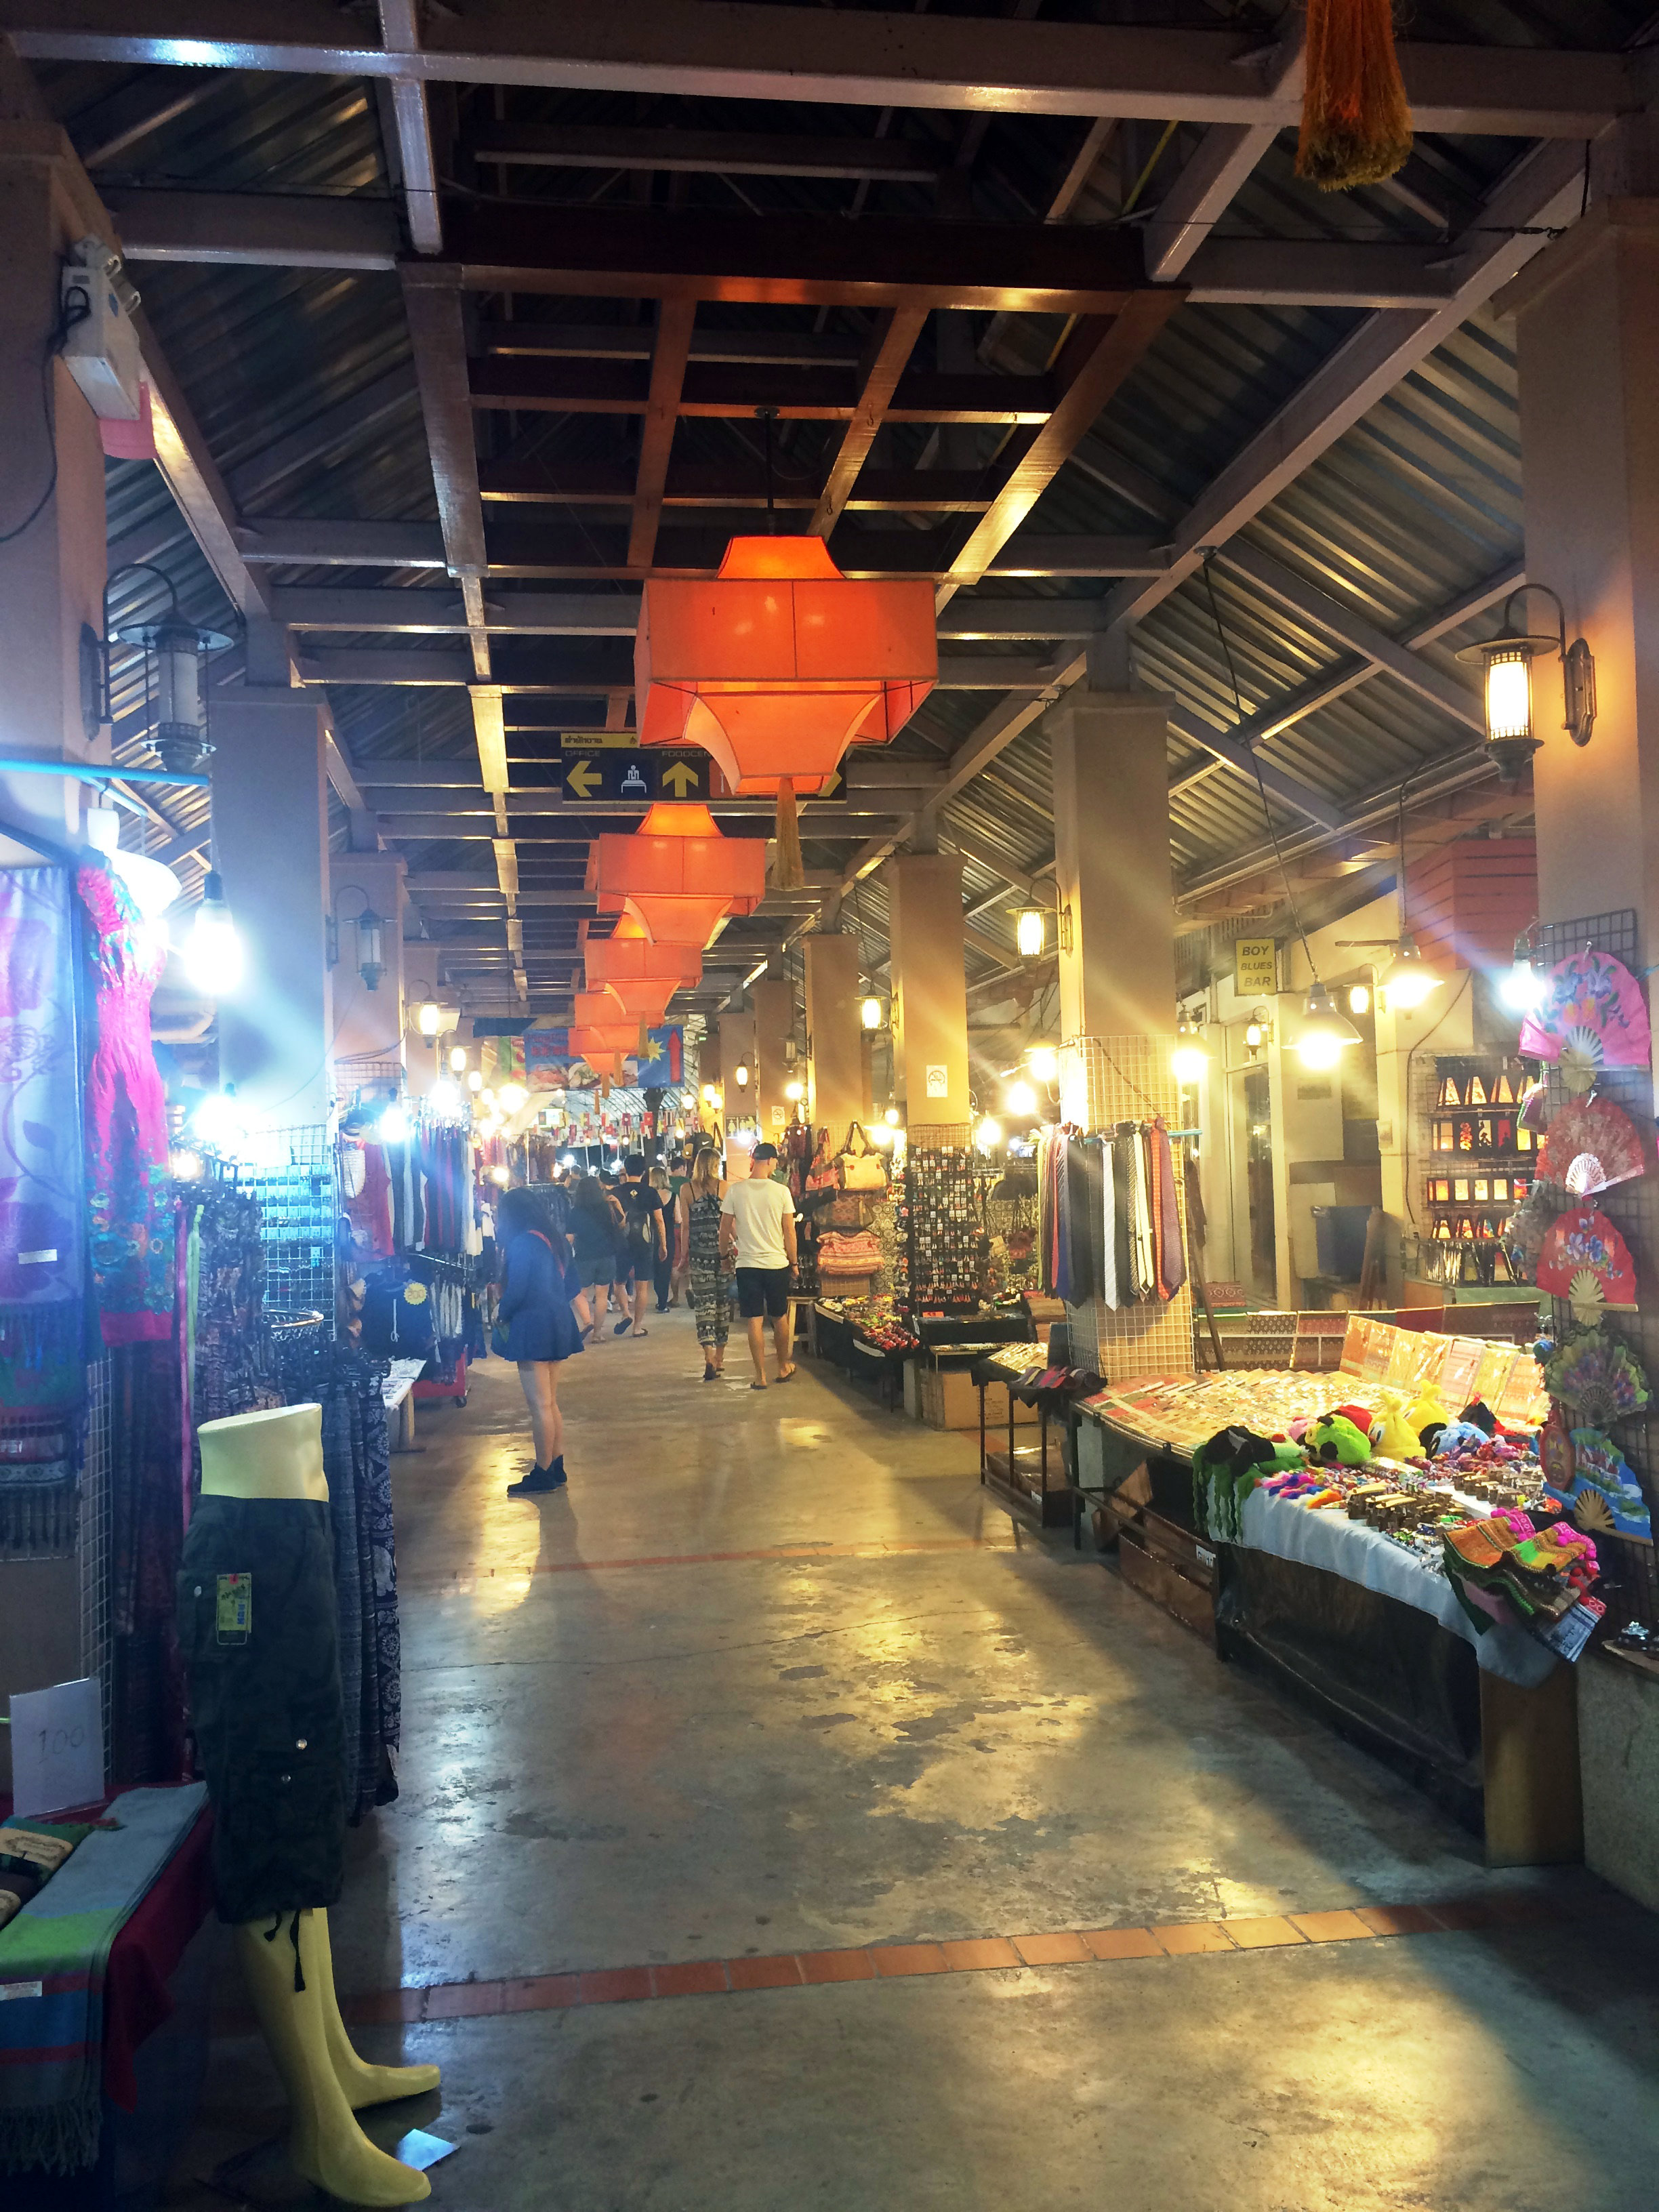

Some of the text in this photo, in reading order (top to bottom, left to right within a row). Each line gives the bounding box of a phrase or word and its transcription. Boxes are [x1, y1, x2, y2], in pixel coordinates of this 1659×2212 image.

[661, 750, 712, 758] FOODCEN
[1242, 945, 1269, 956] BOY
[1241, 962, 1273, 970] BLUES
[1244, 977, 1271, 987] BAR
[38, 1727, 85, 1764] 100
